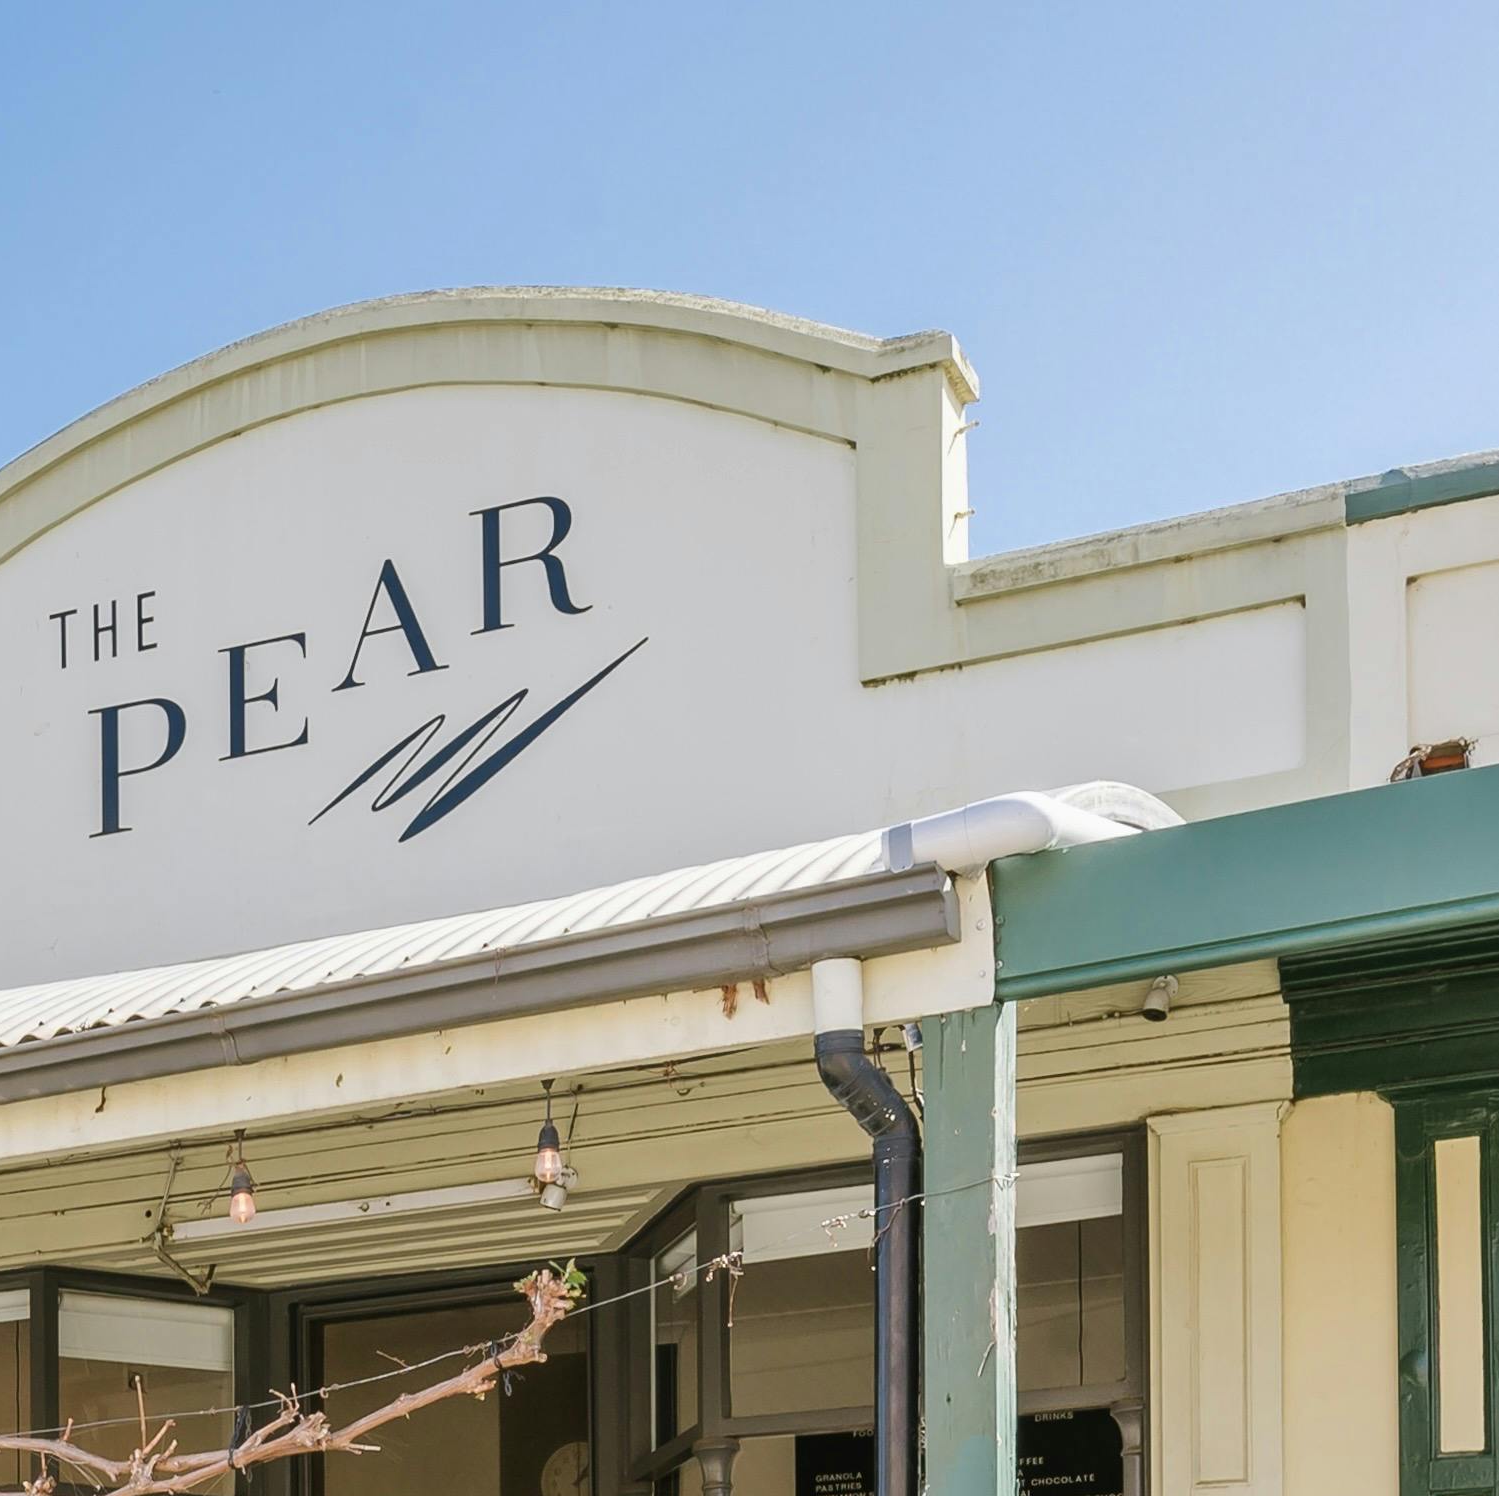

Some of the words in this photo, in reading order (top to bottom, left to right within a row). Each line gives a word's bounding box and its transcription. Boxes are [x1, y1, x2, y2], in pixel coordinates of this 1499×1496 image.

[49, 590, 158, 669] THE
[88, 496, 593, 839] PEAR
[1034, 1411, 1074, 1422] DRINKS
[853, 1429, 874, 1438] FOO
[1019, 1456, 1044, 1466] FFEE
[815, 1471, 863, 1483] GRANOLA
[1031, 1473, 1095, 1487] CHOCOLATE
[815, 1482, 862, 1493] PASTRIES
